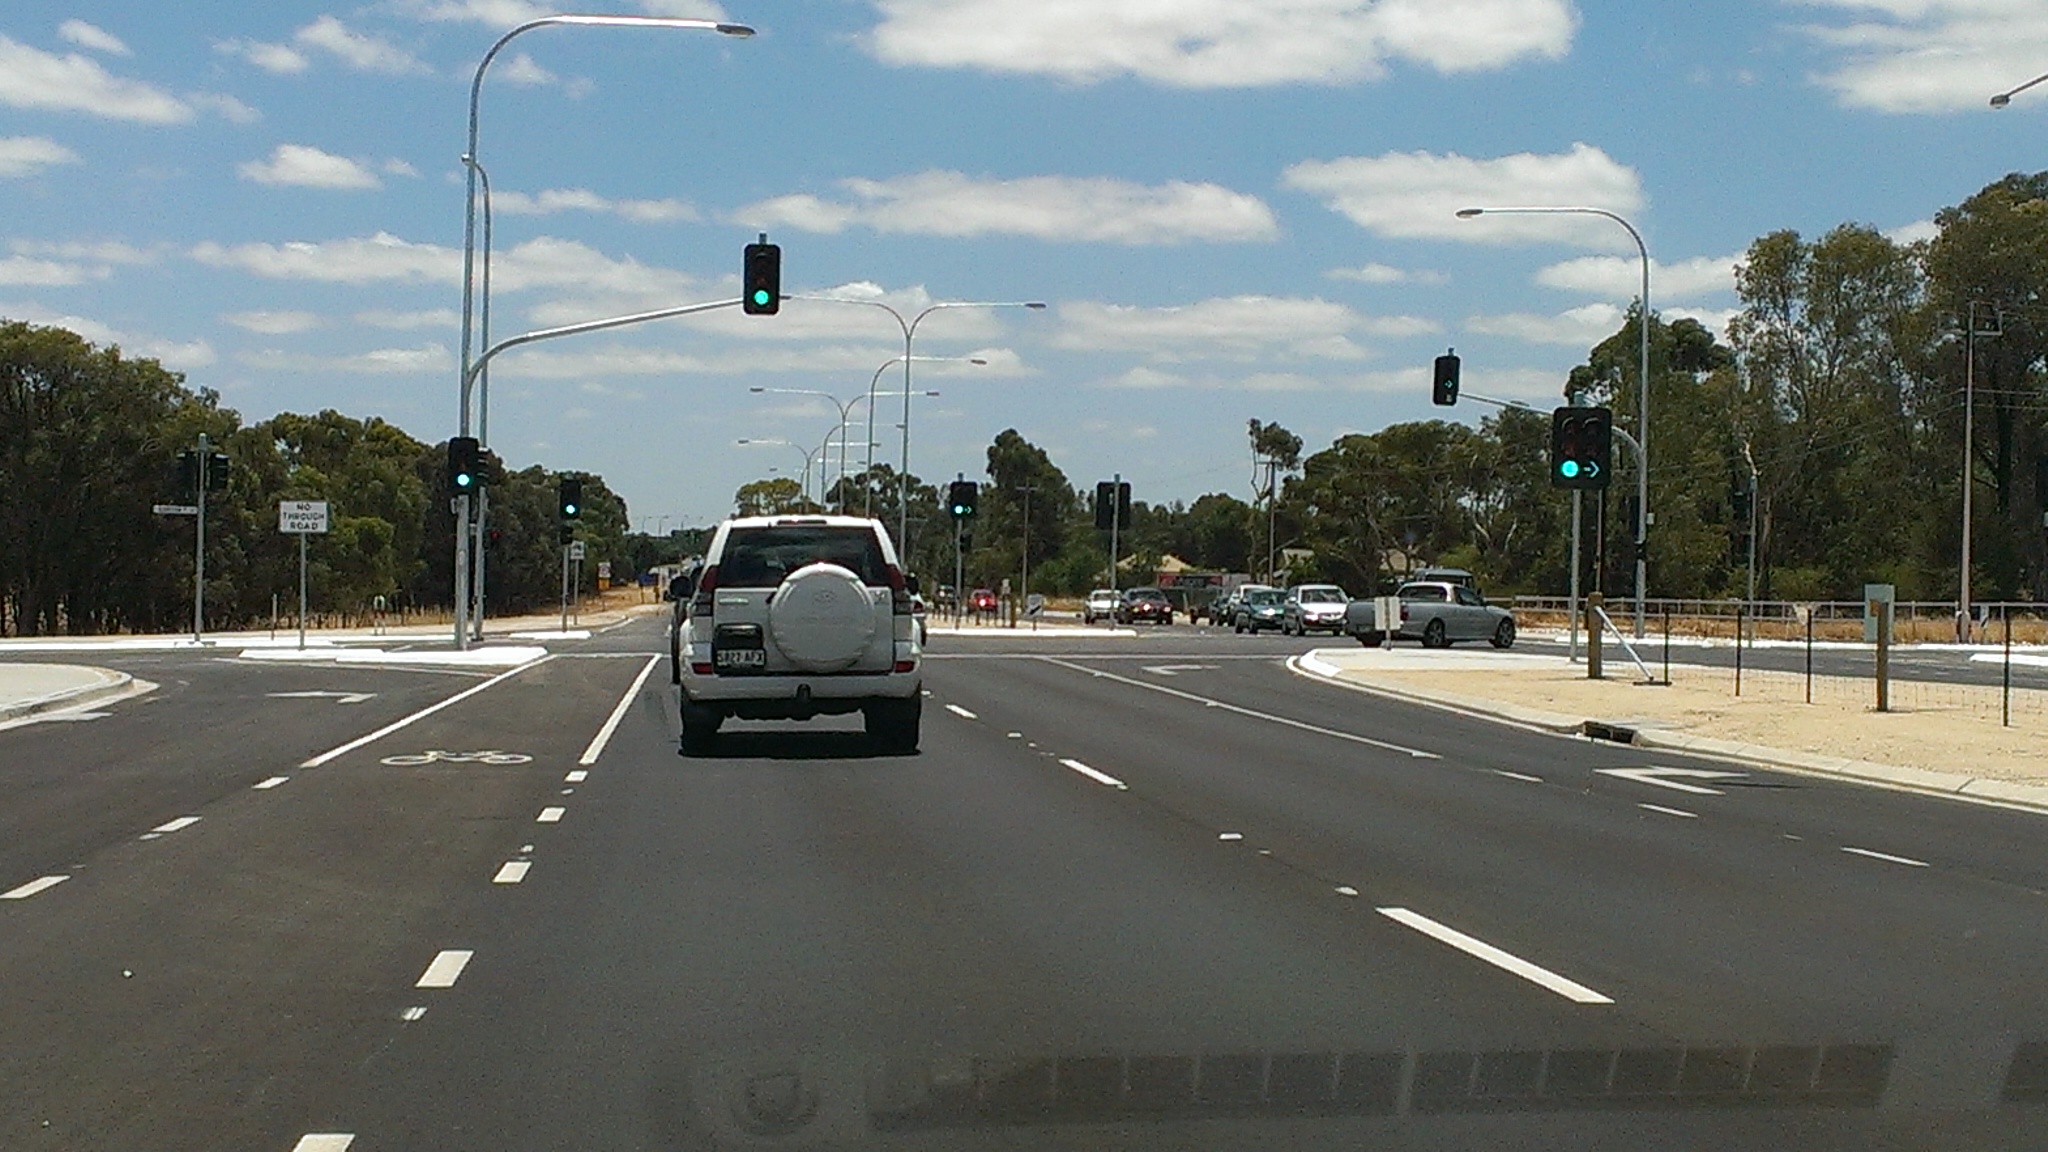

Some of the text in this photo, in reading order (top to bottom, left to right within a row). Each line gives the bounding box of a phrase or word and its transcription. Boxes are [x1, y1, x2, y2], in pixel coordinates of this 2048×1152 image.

[296, 503, 312, 511] NO
[283, 512, 325, 521] THROUGH
[290, 522, 318, 530] ROAD
